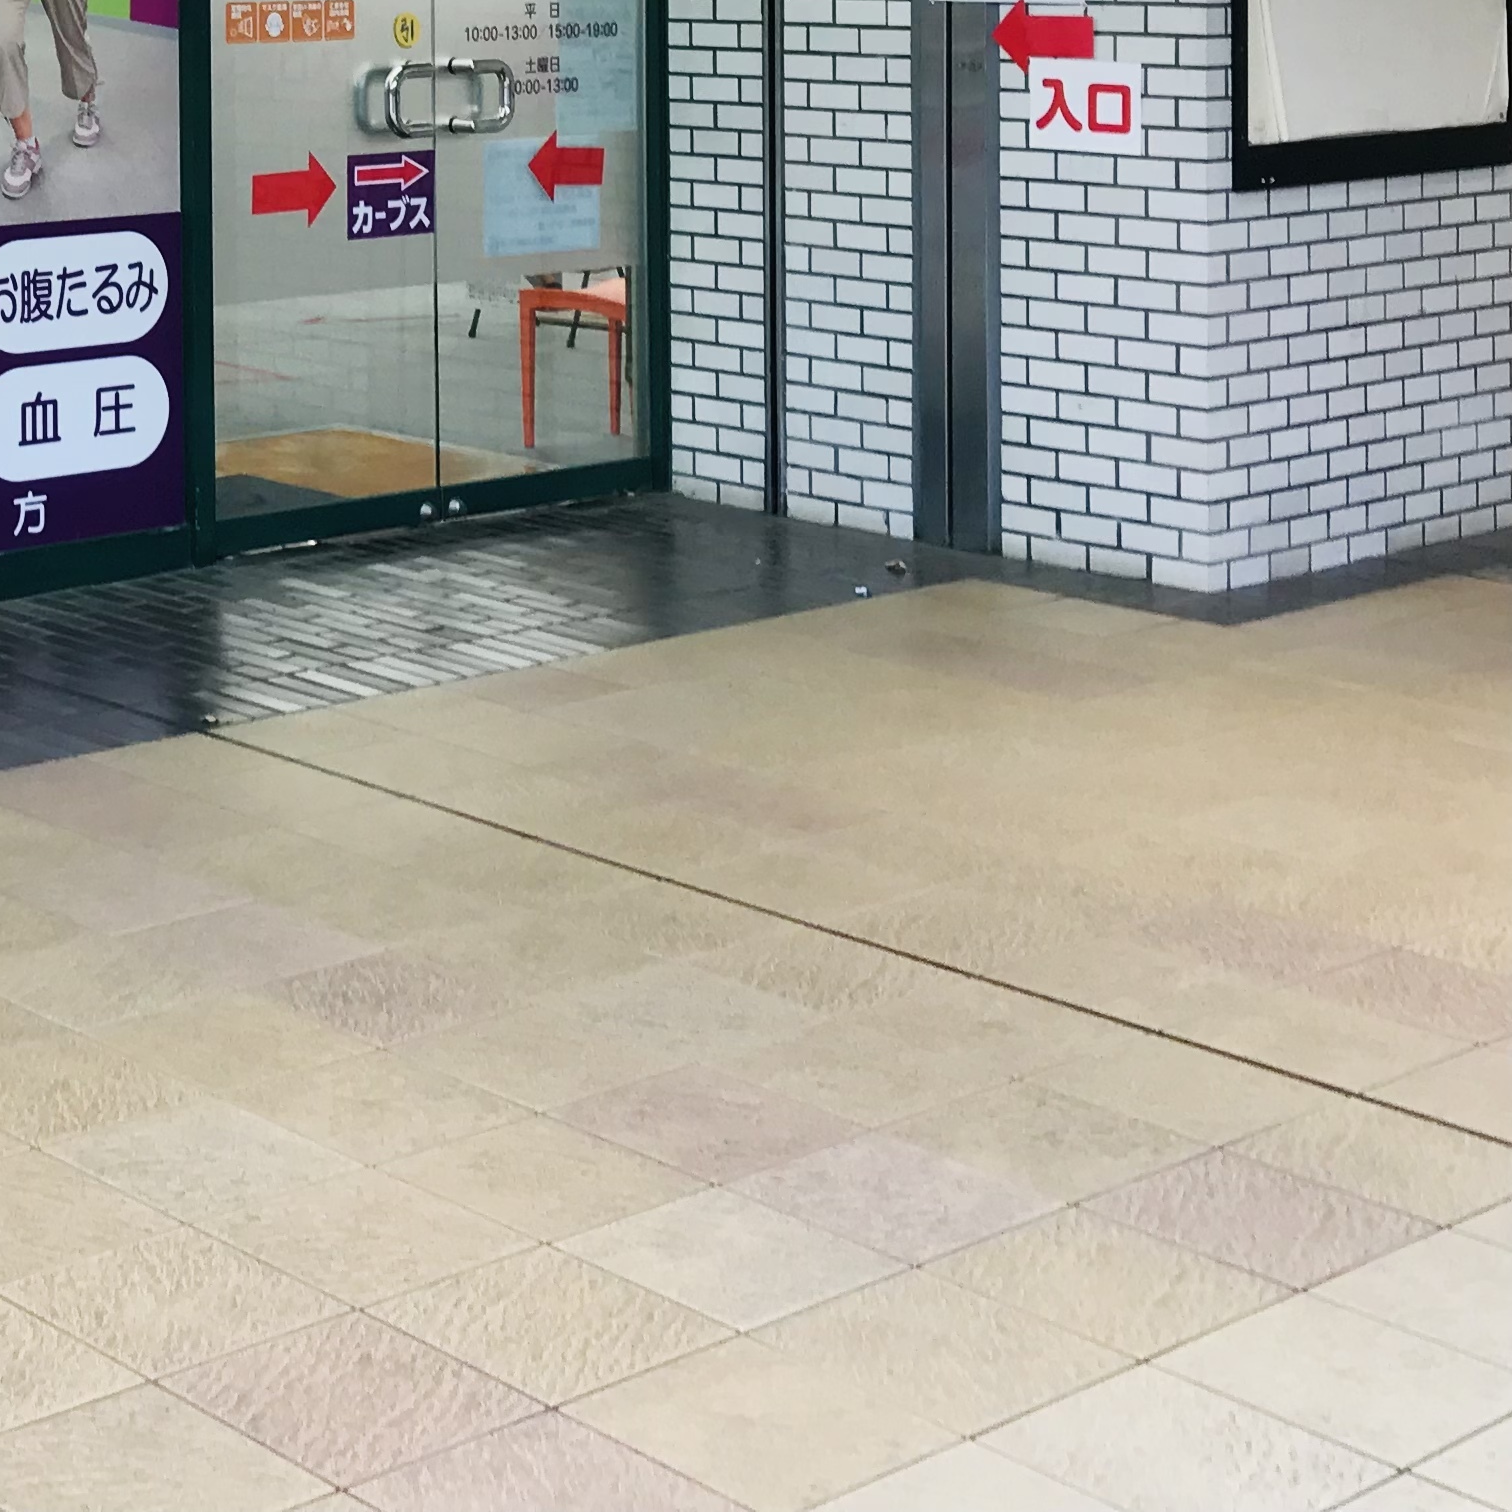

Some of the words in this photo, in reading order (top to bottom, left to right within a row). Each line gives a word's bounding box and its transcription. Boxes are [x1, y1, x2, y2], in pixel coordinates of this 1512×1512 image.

[400, 18, 414, 42] 引
[465, 24, 538, 42] 10:00-13:00
[525, 56, 561, 74] 土曜日
[514, 77, 579, 95] 0:00-13:00
[1036, 78, 1131, 134] 入口
[352, 194, 431, 234] カーブス
[19, 383, 137, 446] 血圧
